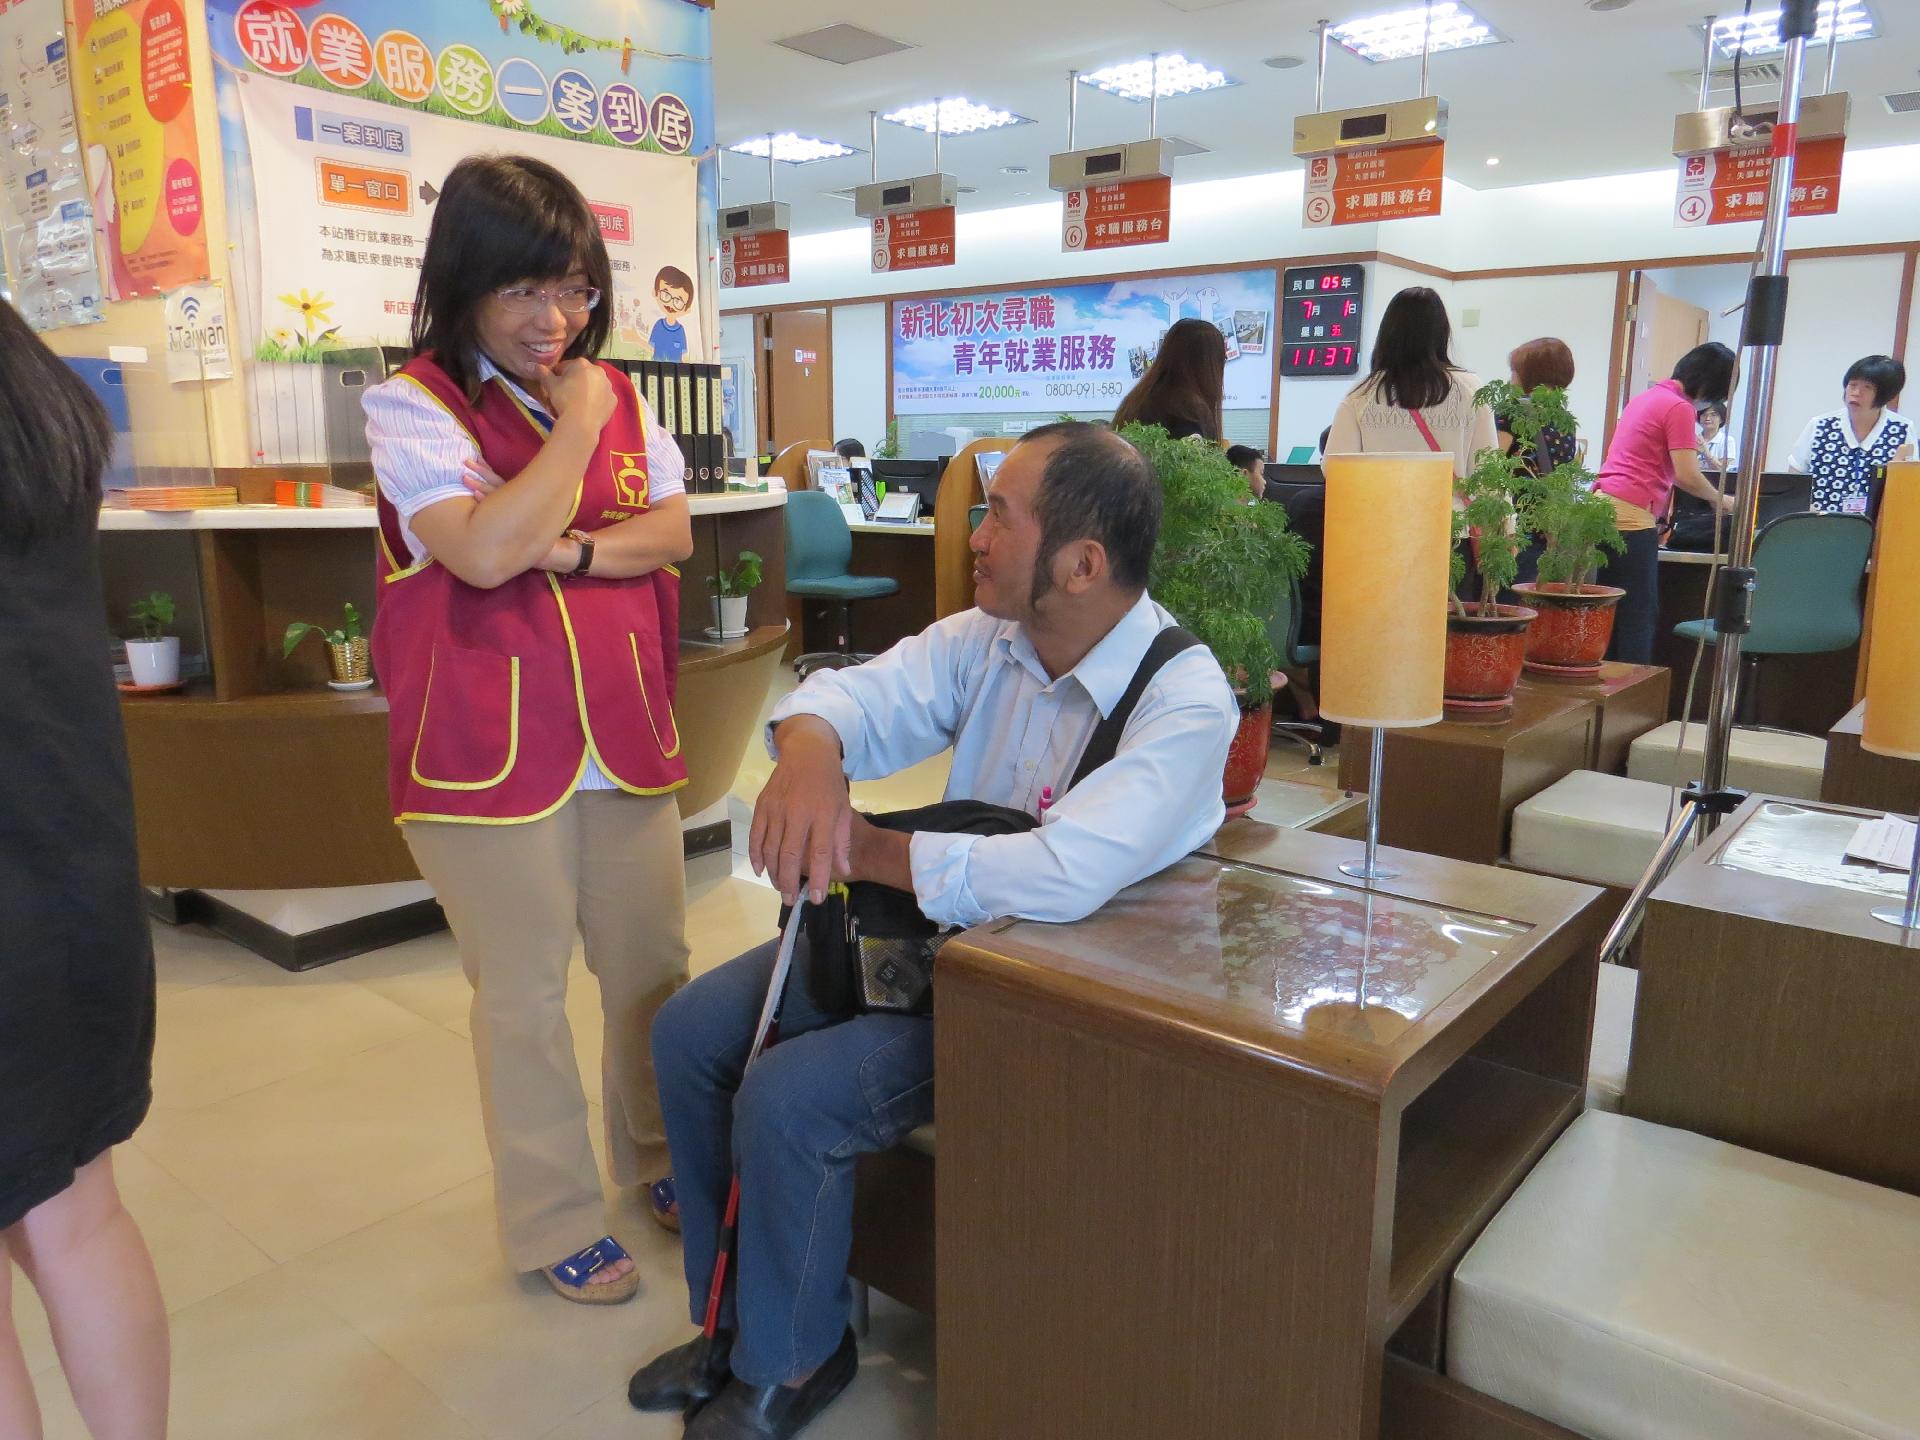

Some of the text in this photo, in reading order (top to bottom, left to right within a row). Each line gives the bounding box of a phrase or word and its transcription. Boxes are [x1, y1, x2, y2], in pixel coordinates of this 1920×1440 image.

[243, 9, 688, 150] 就業服務一案到底
[322, 122, 404, 152] 一案到底
[329, 173, 400, 201] 單一窗口
[1345, 187, 1433, 210] 求職服務台
[1725, 185, 1829, 209] 求職務台
[1313, 202, 1323, 218] 5
[1687, 201, 1698, 217] 4
[597, 214, 625, 232] 到底
[1095, 218, 1162, 237] 求職服務台
[319, 225, 431, 249] 本站推行就業服務一
[1070, 231, 1077, 243] 6
[901, 295, 1055, 340] 新北初次尋職
[169, 324, 226, 352] iTaiwan
[953, 334, 1117, 375] 青年就業服務
